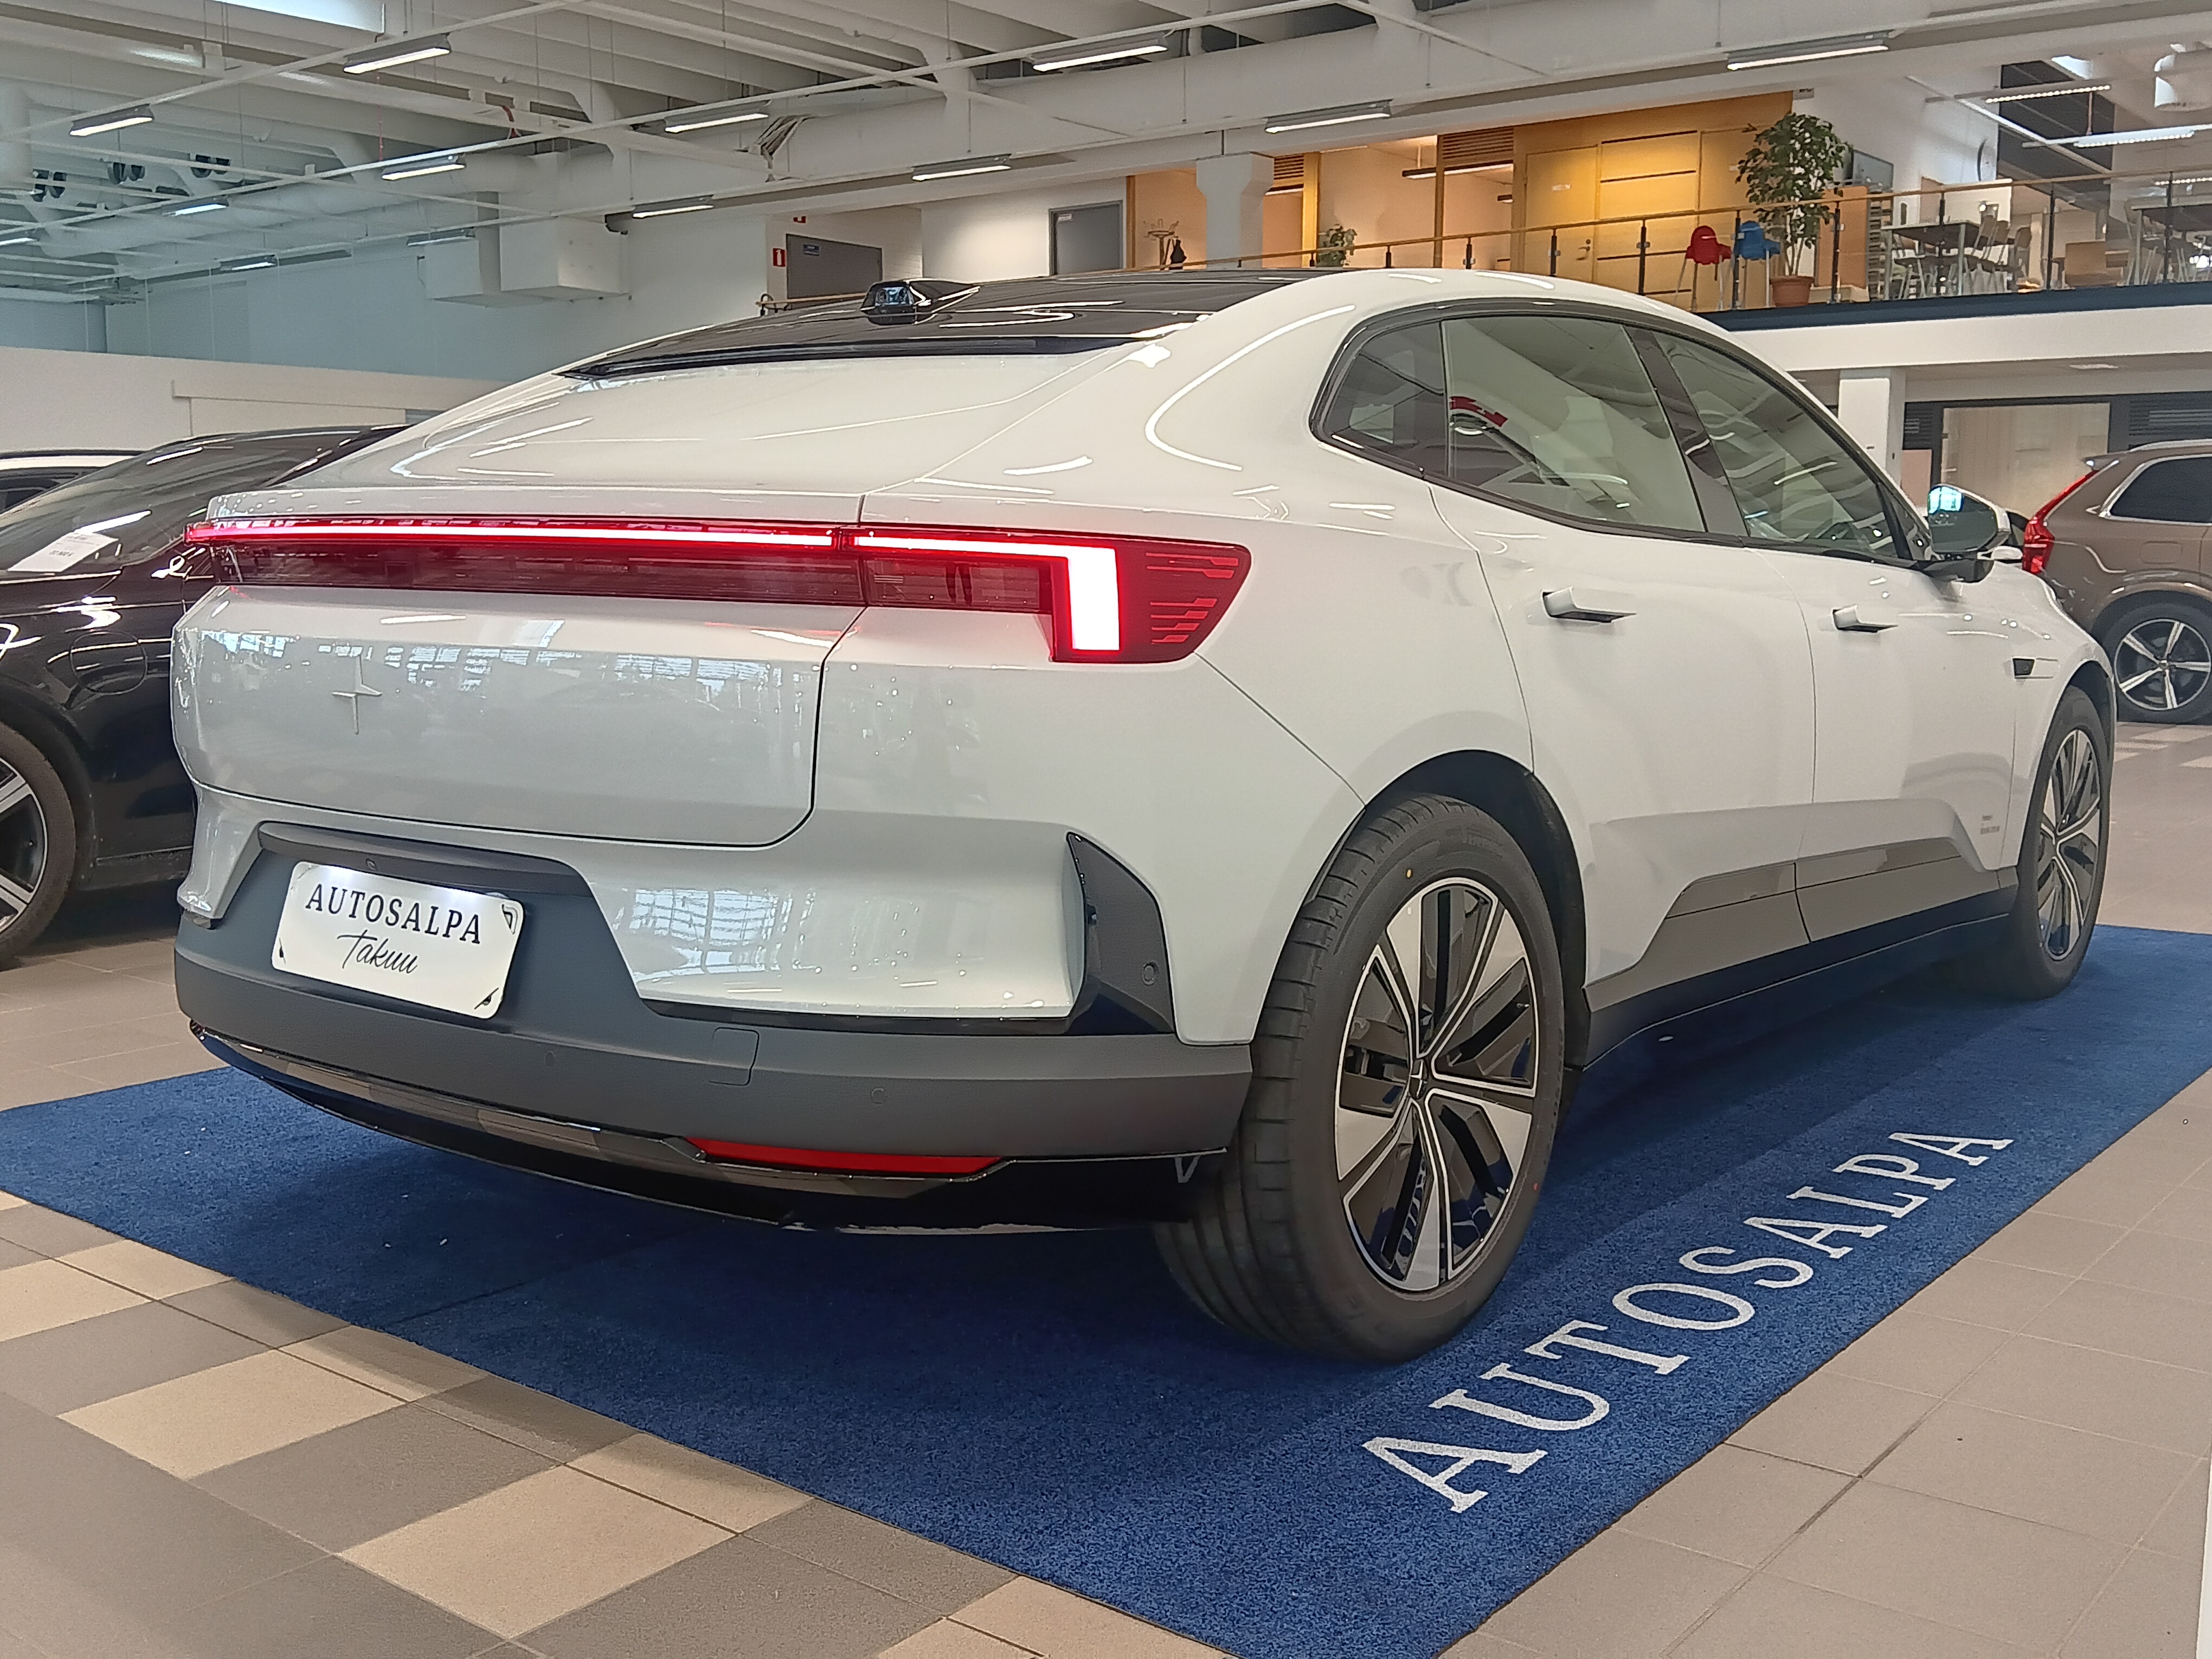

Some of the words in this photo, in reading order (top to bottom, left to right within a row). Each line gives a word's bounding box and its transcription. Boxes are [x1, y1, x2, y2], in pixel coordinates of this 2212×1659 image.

[305, 884, 481, 944] AUTOSALPA
[337, 929, 418, 974] Takuu
[1361, 1132, 2014, 1514] AUTOSALPA
